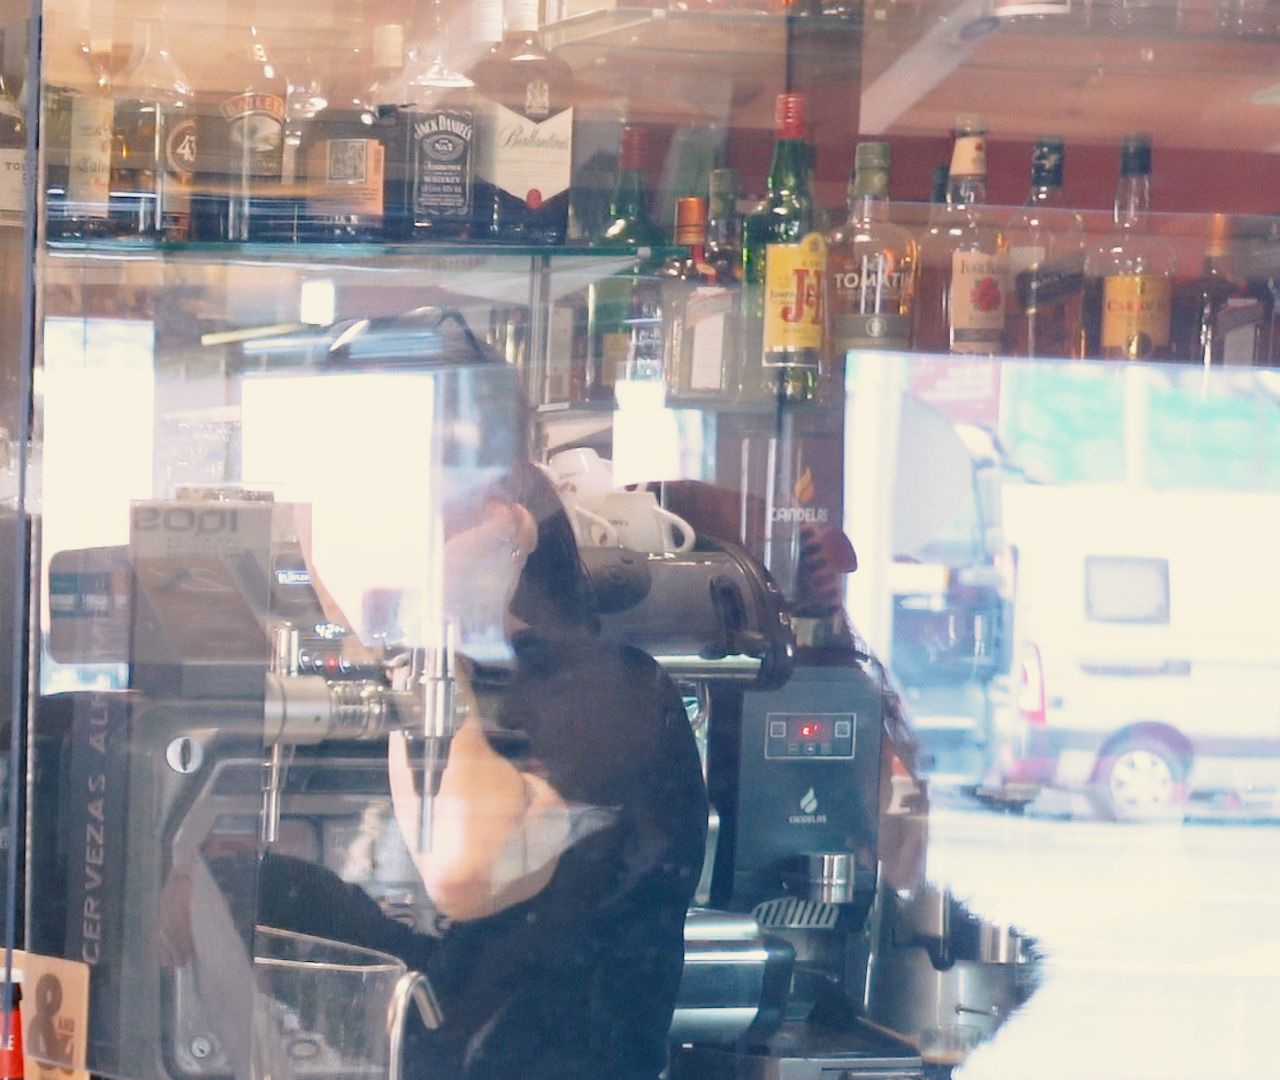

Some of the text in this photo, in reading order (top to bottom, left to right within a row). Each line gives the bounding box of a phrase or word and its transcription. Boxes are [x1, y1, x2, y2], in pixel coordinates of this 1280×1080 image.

[414, 118, 439, 139] JACK
[834, 272, 911, 289] TOMATI
[81, 773, 107, 965] CERVEZAS
